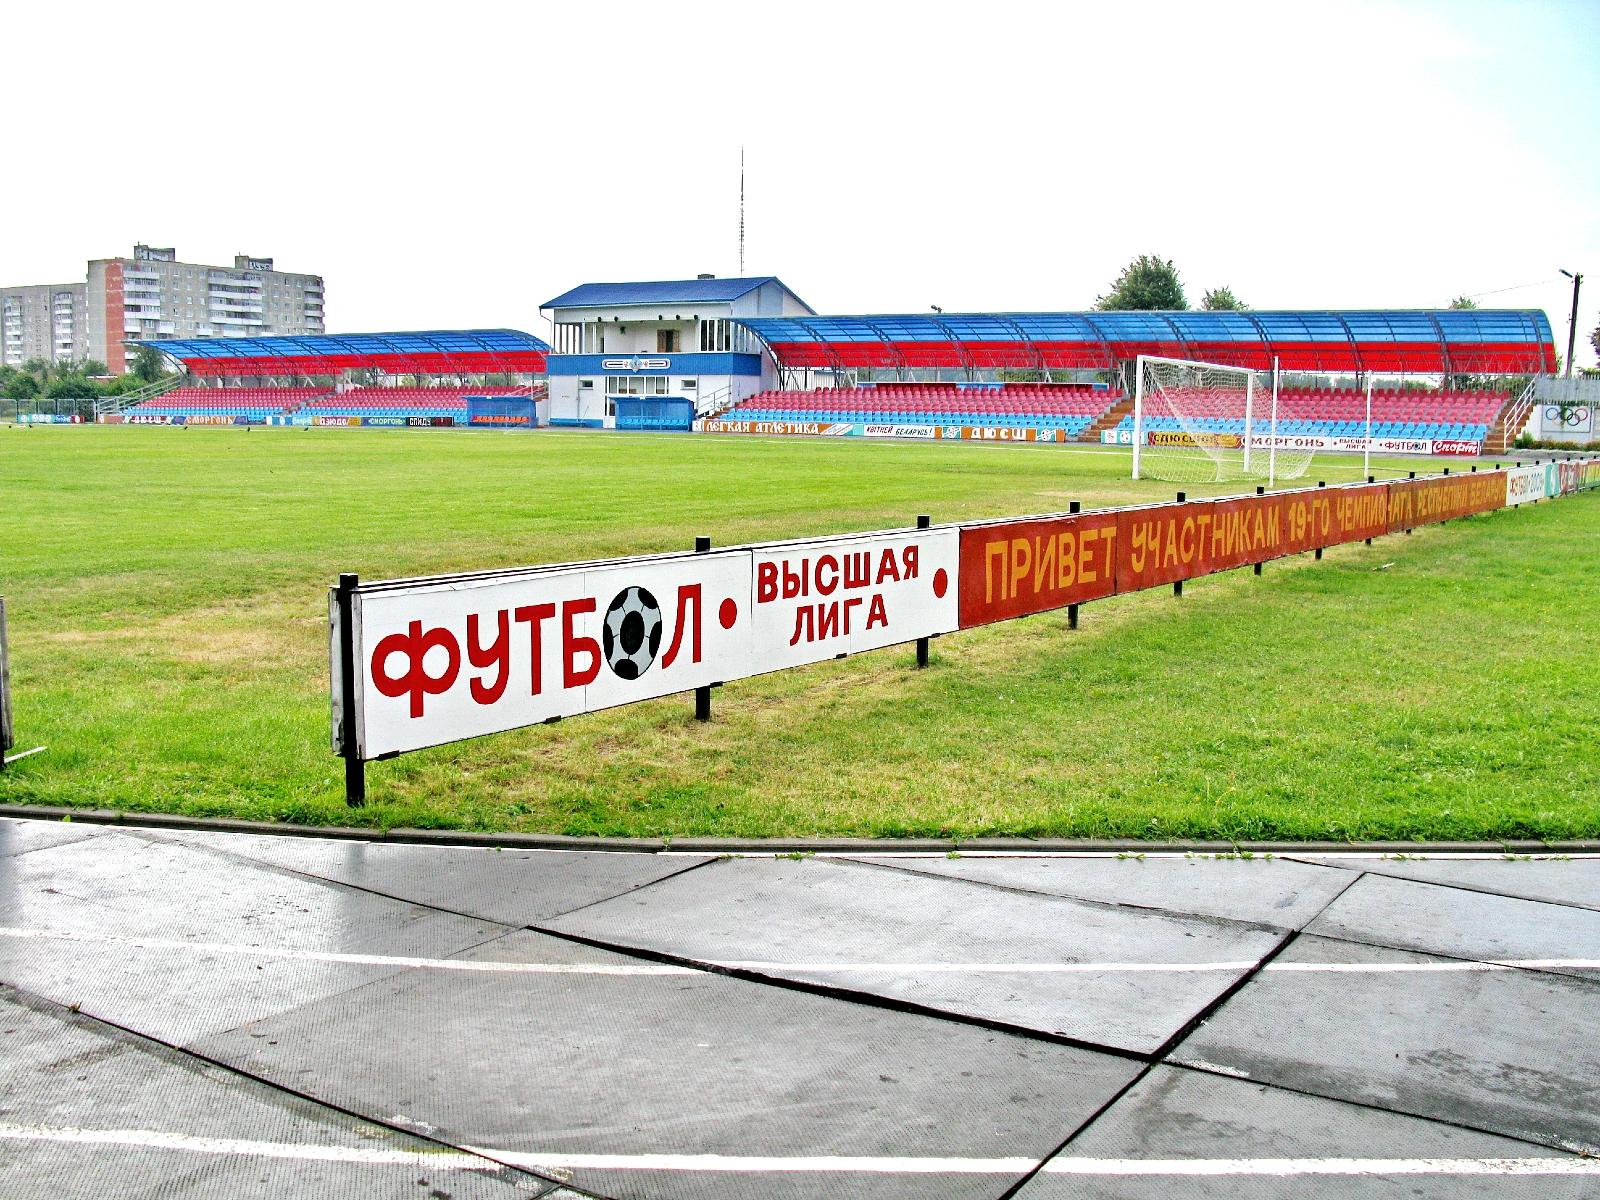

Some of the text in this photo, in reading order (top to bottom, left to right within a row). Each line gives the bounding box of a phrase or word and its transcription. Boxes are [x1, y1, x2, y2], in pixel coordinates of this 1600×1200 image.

[706, 422, 819, 435] ЛЕГКАЯ АТЛЕТИКА
[970, 427, 1027, 440] ДЮСШ
[1433, 441, 1477, 455] Спорт
[985, 526, 1117, 604] ПРИВЕТ
[1131, 505, 1280, 573] УЧАСТНИКАМ
[1288, 498, 1330, 541] 19-ГО
[758, 545, 919, 604] ВЫСШАЯ
[789, 593, 888, 647] ЛИГА
